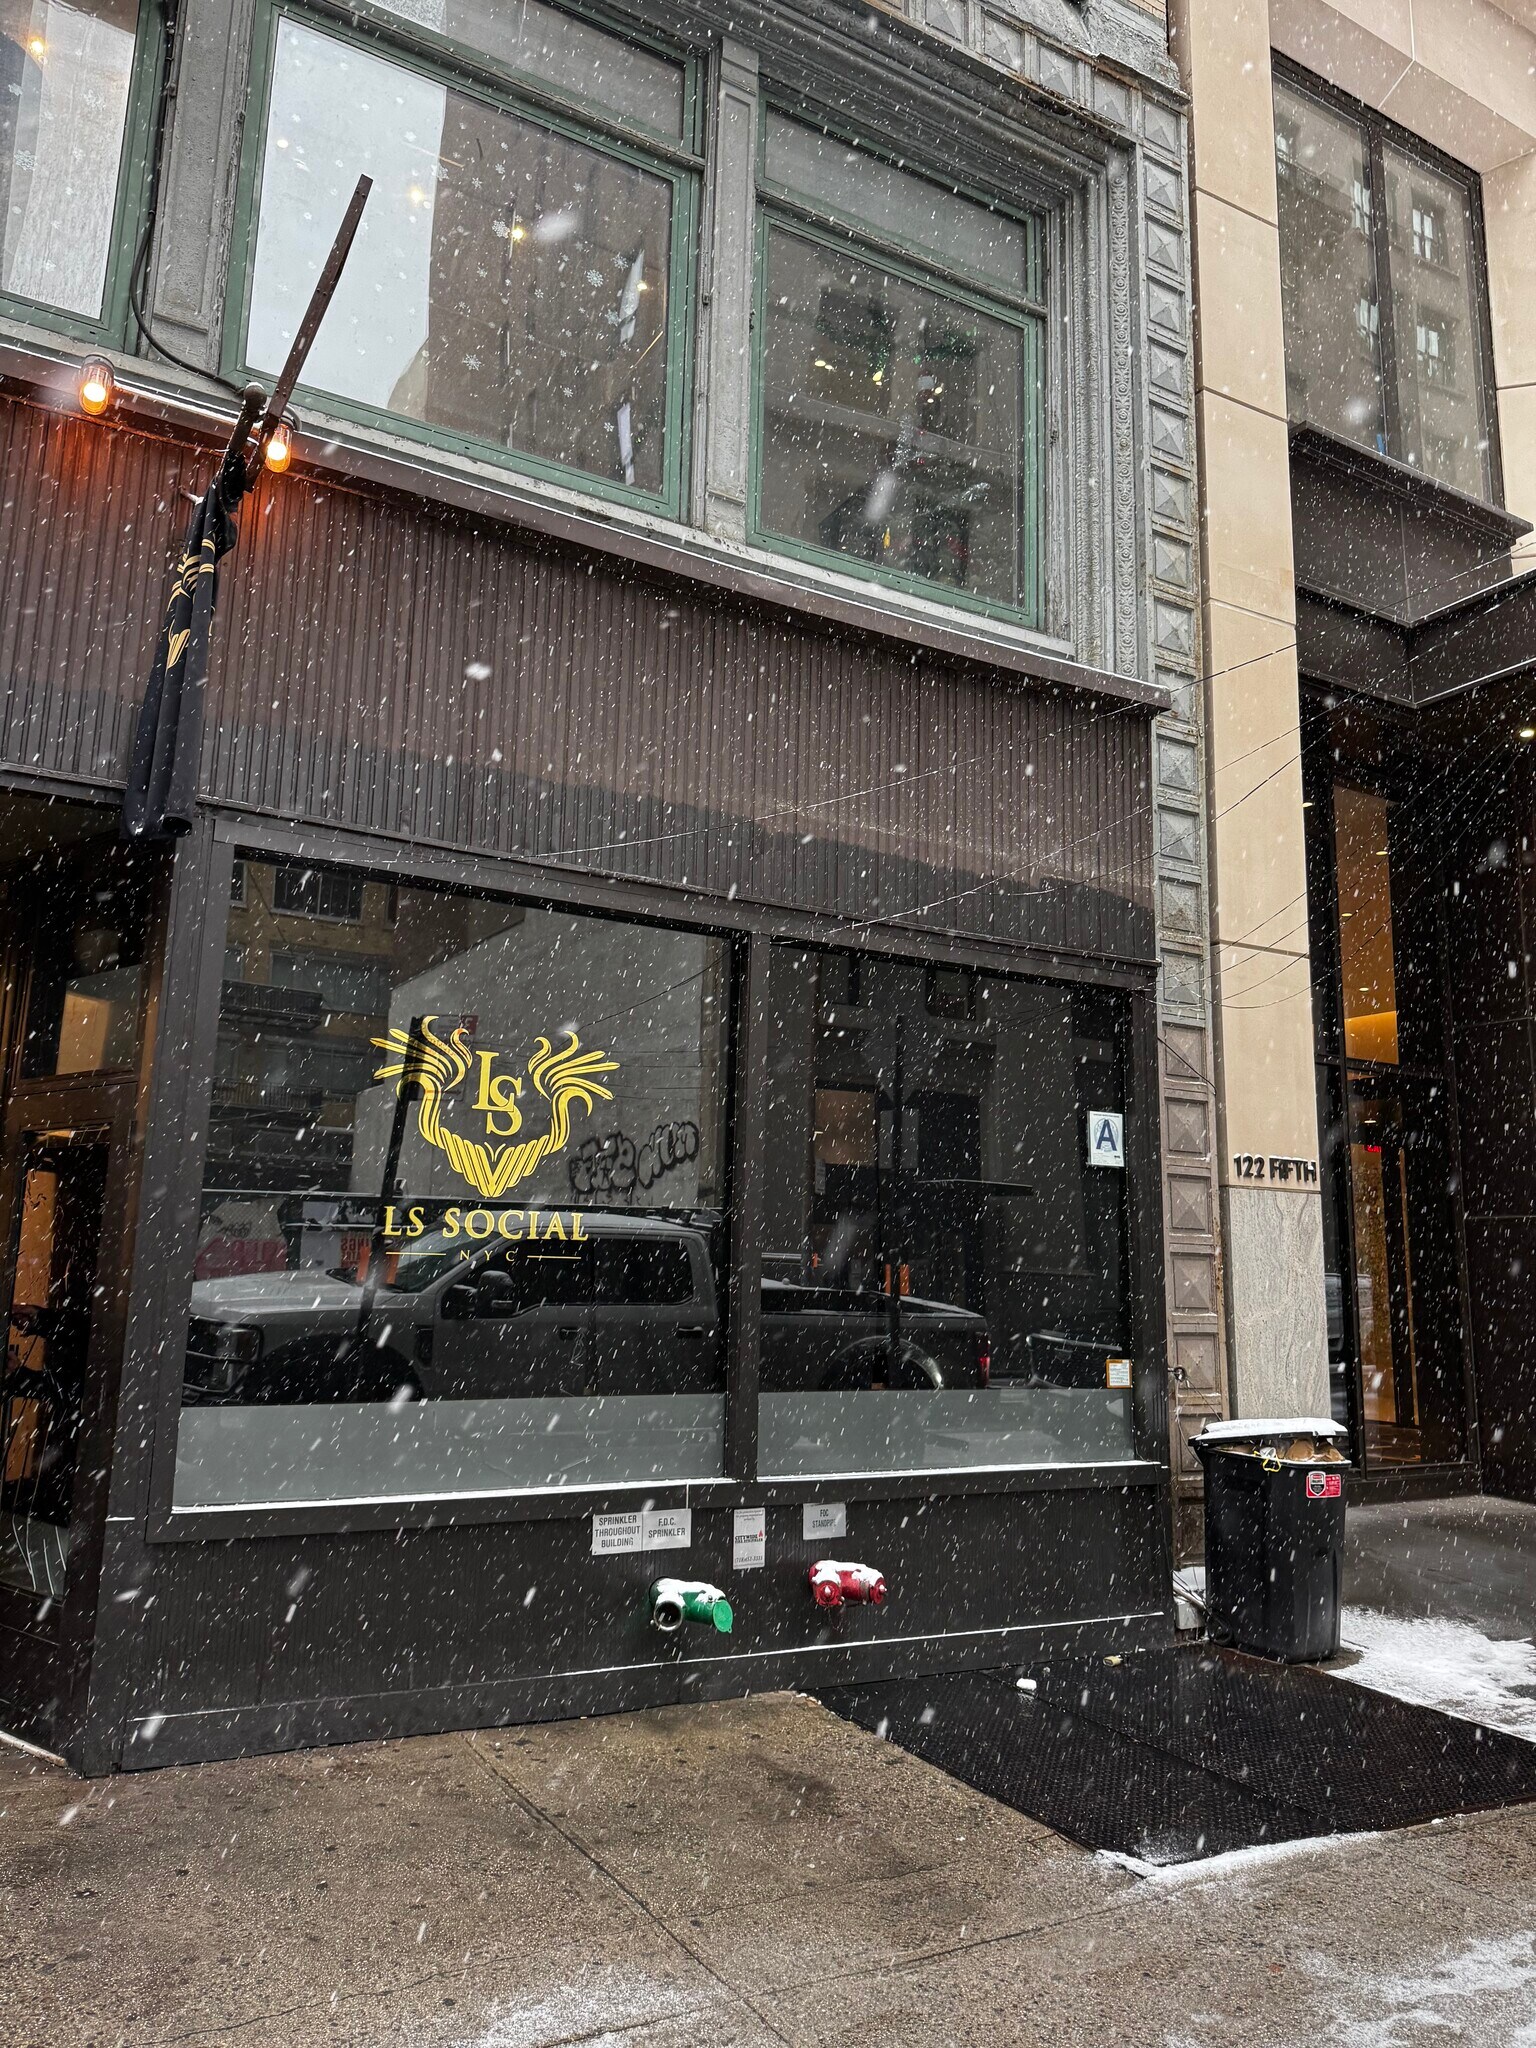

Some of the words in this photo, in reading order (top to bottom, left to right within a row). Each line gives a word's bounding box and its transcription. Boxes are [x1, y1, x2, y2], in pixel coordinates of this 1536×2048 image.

[1096, 1119, 1117, 1151] A
[1234, 1153, 1265, 1178] 122
[1269, 1156, 1318, 1182] FIFTH
[381, 1205, 425, 1237] LS
[442, 1207, 589, 1241] SOCIAL
[599, 1514, 637, 1527] SPRINKLER
[595, 1525, 641, 1538] THROUGHOUT
[648, 1527, 686, 1539] SPRINKLER
[601, 1537, 634, 1548] BUILDING
